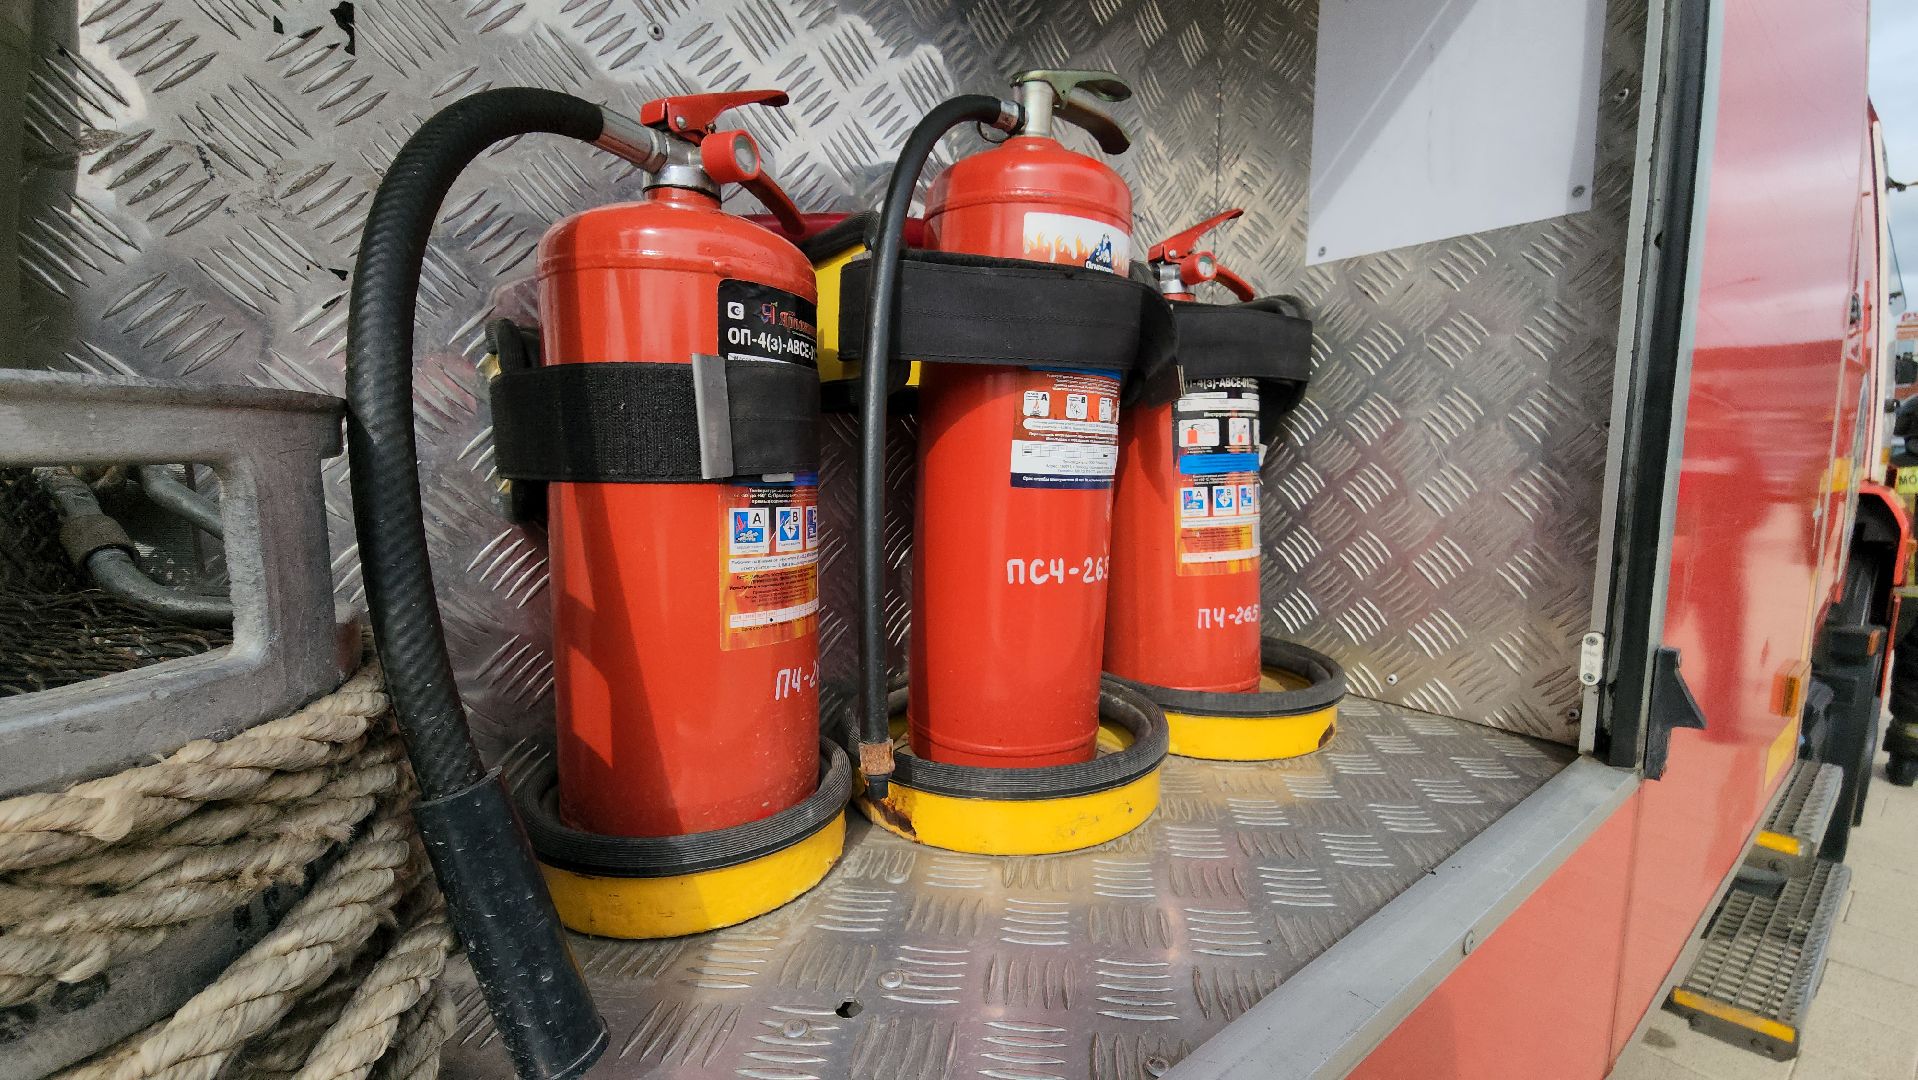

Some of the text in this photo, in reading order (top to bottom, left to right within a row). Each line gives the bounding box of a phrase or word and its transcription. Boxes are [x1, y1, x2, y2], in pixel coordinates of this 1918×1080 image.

[752, 512, 762, 525] A
[792, 511, 799, 523] B
[1197, 603, 1259, 629] ПЧ-265
